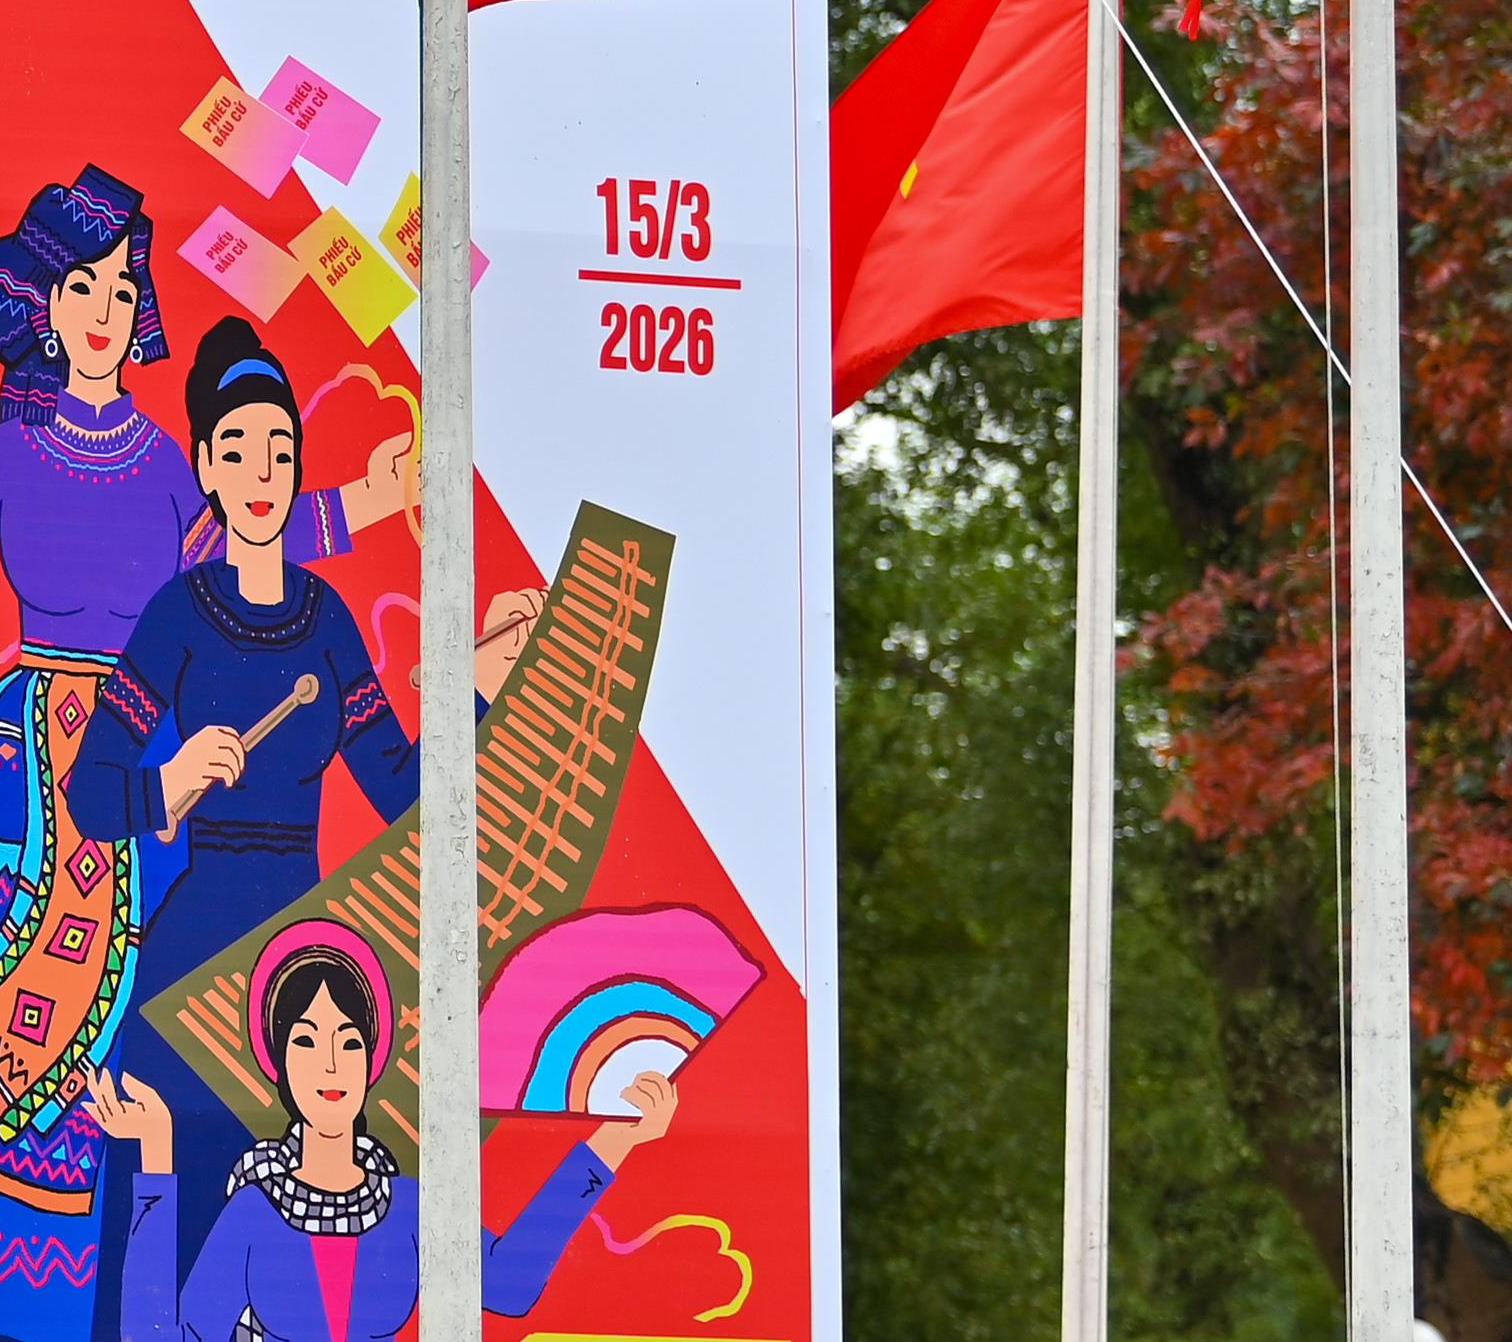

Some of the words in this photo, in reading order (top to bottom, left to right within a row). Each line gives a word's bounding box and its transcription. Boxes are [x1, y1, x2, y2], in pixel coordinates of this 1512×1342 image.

[202, 95, 232, 133] PHIẾU
[231, 100, 247, 122] CỬ
[596, 177, 711, 262] 15/3
[319, 236, 349, 269] PHIẾU
[345, 245, 362, 267] CỬ
[600, 302, 714, 376] 2026
